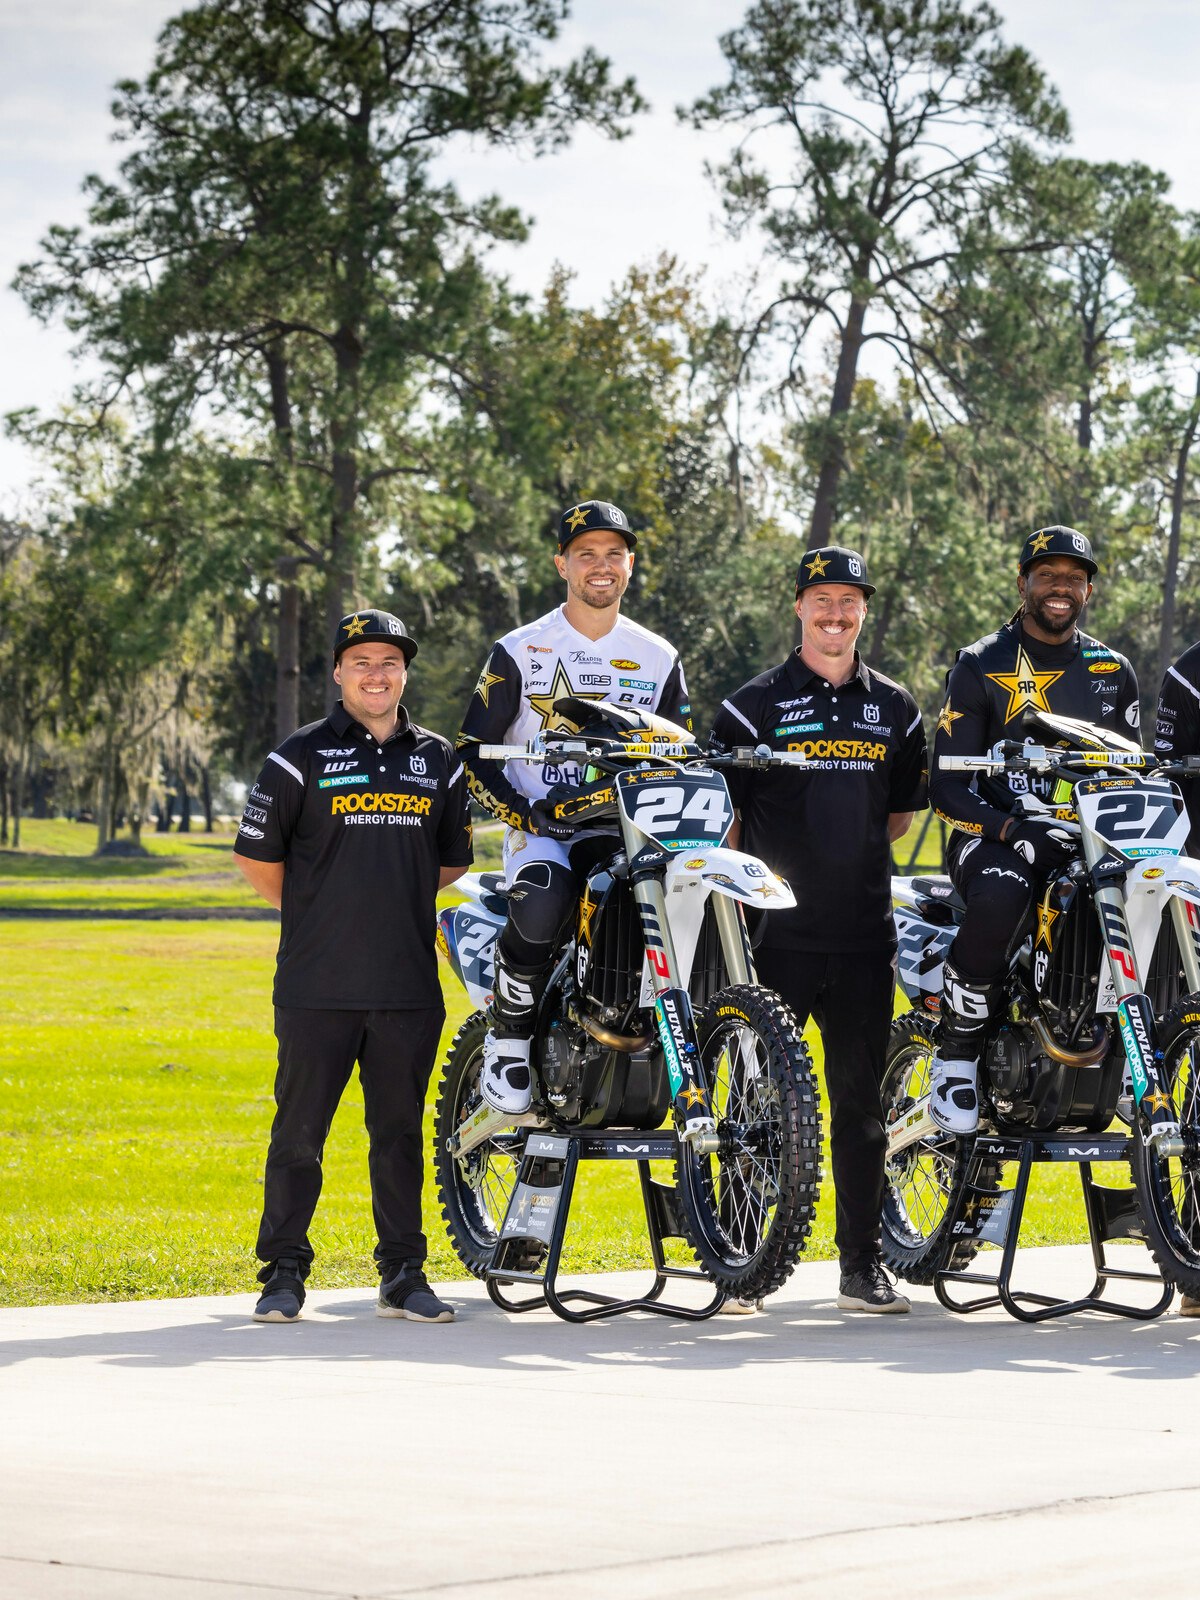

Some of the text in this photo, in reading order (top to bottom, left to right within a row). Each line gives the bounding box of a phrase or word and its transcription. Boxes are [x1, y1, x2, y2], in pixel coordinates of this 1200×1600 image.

[579, 674, 611, 687] WPS
[780, 709, 815, 722] WP
[787, 723, 821, 734] MOTOREX
[853, 721, 892, 734] Husqvarna
[788, 740, 887, 761] ROCKSTAR
[324, 761, 359, 773] WP
[842, 761, 875, 772] DRINK
[332, 775, 368, 786] MOTOREX
[400, 774, 438, 787] Husqvarna
[641, 770, 677, 779] ROCKSTAR
[332, 793, 432, 816] ROCKSTAR
[634, 787, 730, 834] 24
[345, 815, 422, 826] ENERGY DRINK
[1095, 794, 1181, 841] 27
[1128, 1004, 1159, 1081] DUNLOP
[658, 1022, 681, 1082] MOTOREX
[1123, 1028, 1146, 1086] MOTOREX
[952, 1221, 966, 1233] 27
